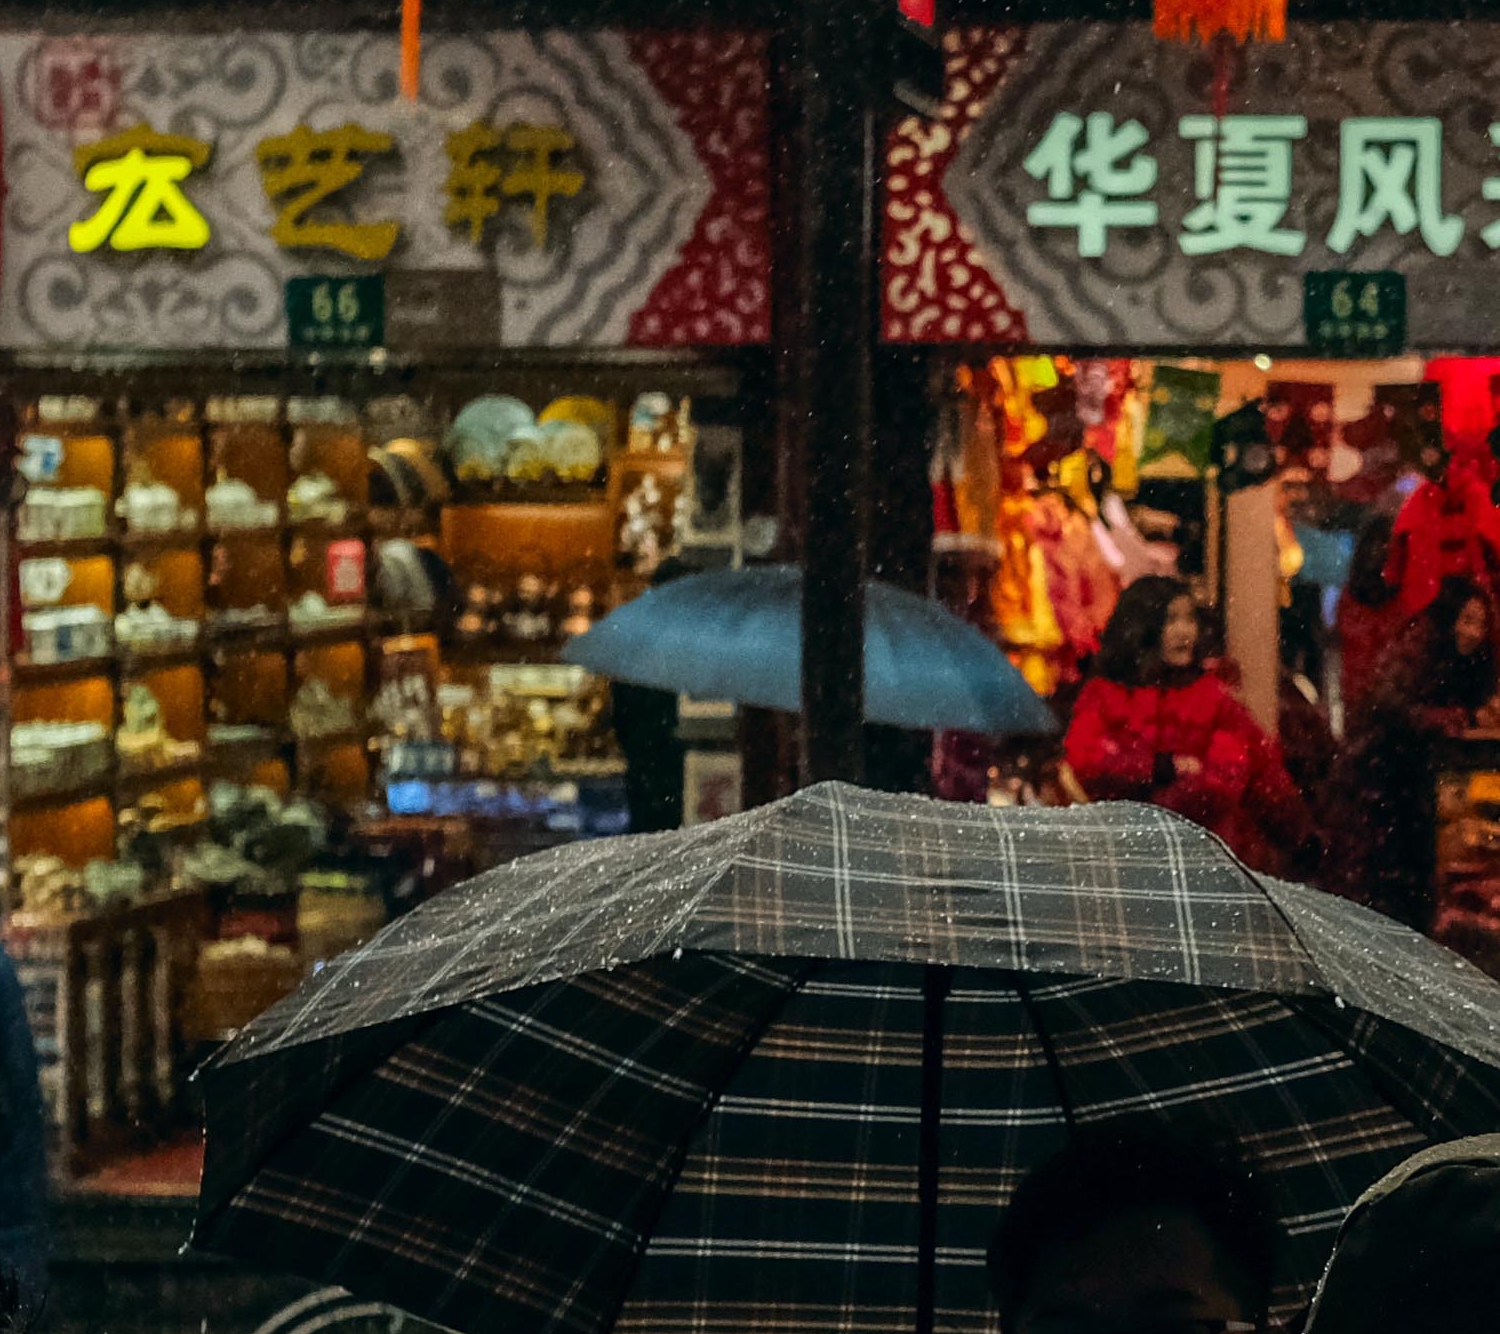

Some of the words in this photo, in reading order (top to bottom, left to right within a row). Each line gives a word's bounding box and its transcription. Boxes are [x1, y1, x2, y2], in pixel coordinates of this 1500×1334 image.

[68, 120, 587, 260] 宏艺轩
[312, 281, 360, 322] 66
[1332, 278, 1380, 320] 64
